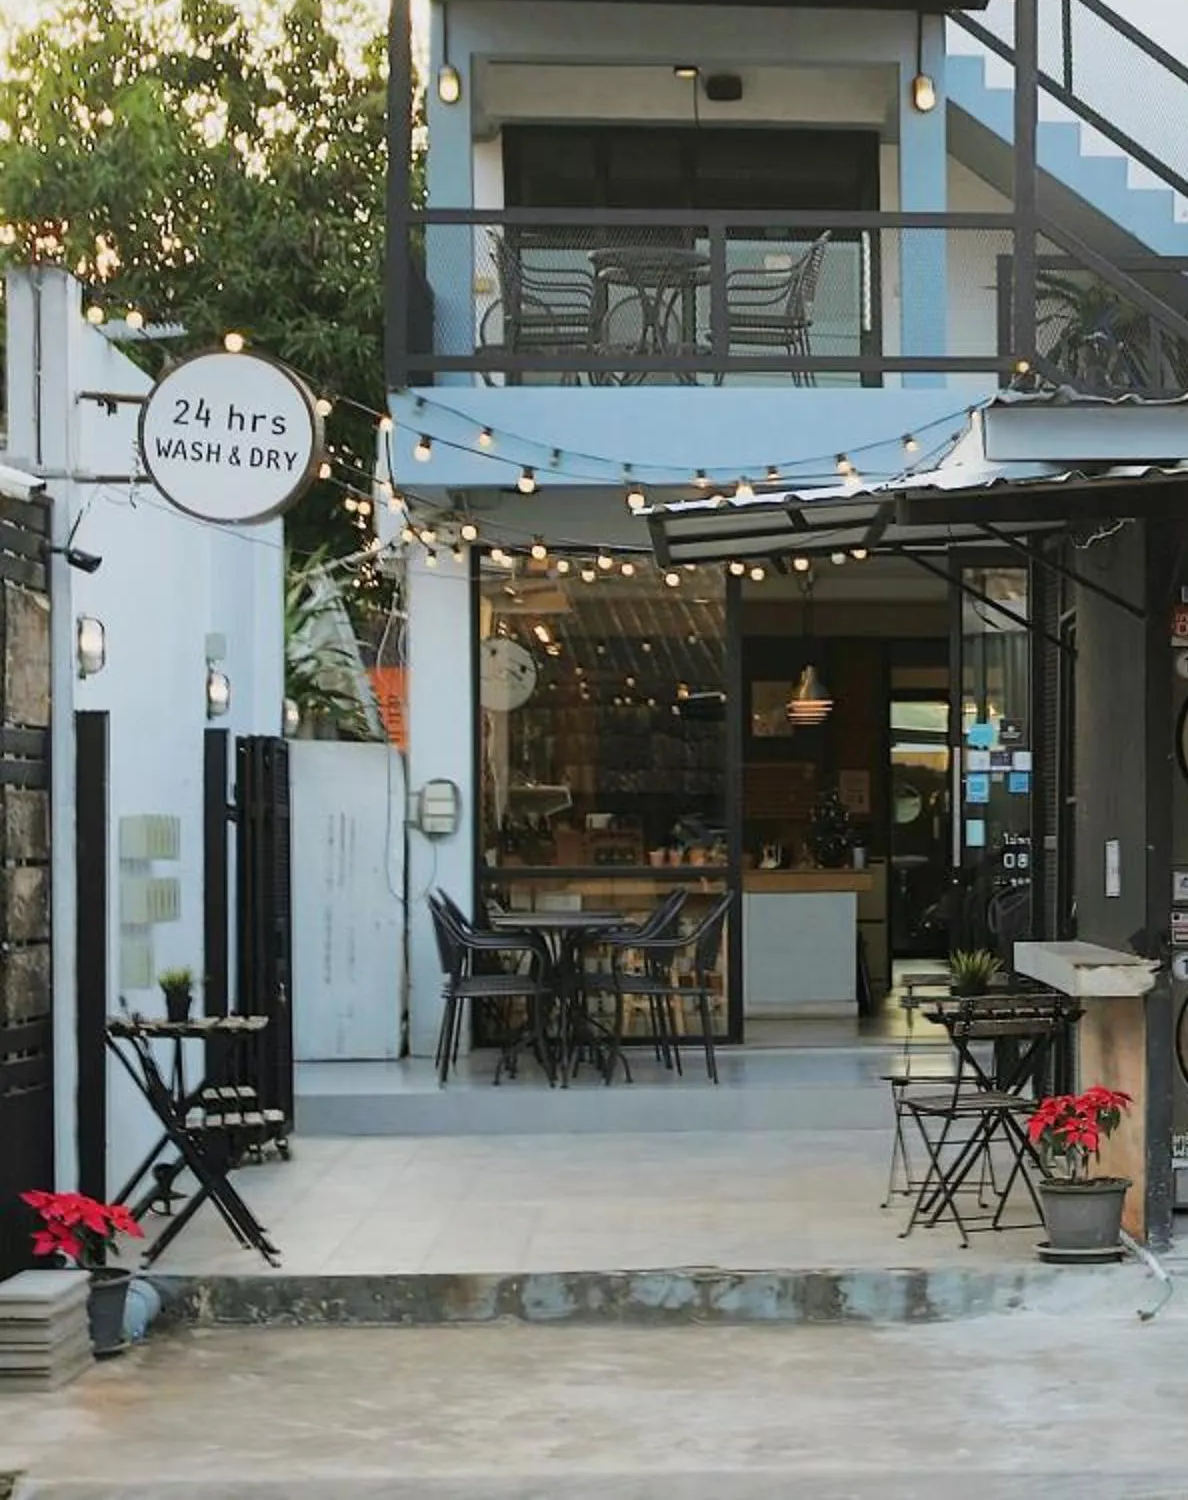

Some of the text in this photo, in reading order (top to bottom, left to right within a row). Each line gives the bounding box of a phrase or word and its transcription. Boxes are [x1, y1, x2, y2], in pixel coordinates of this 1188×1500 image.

[174, 398, 287, 435] 24 hrs
[155, 437, 298, 471] WASH & DRY
